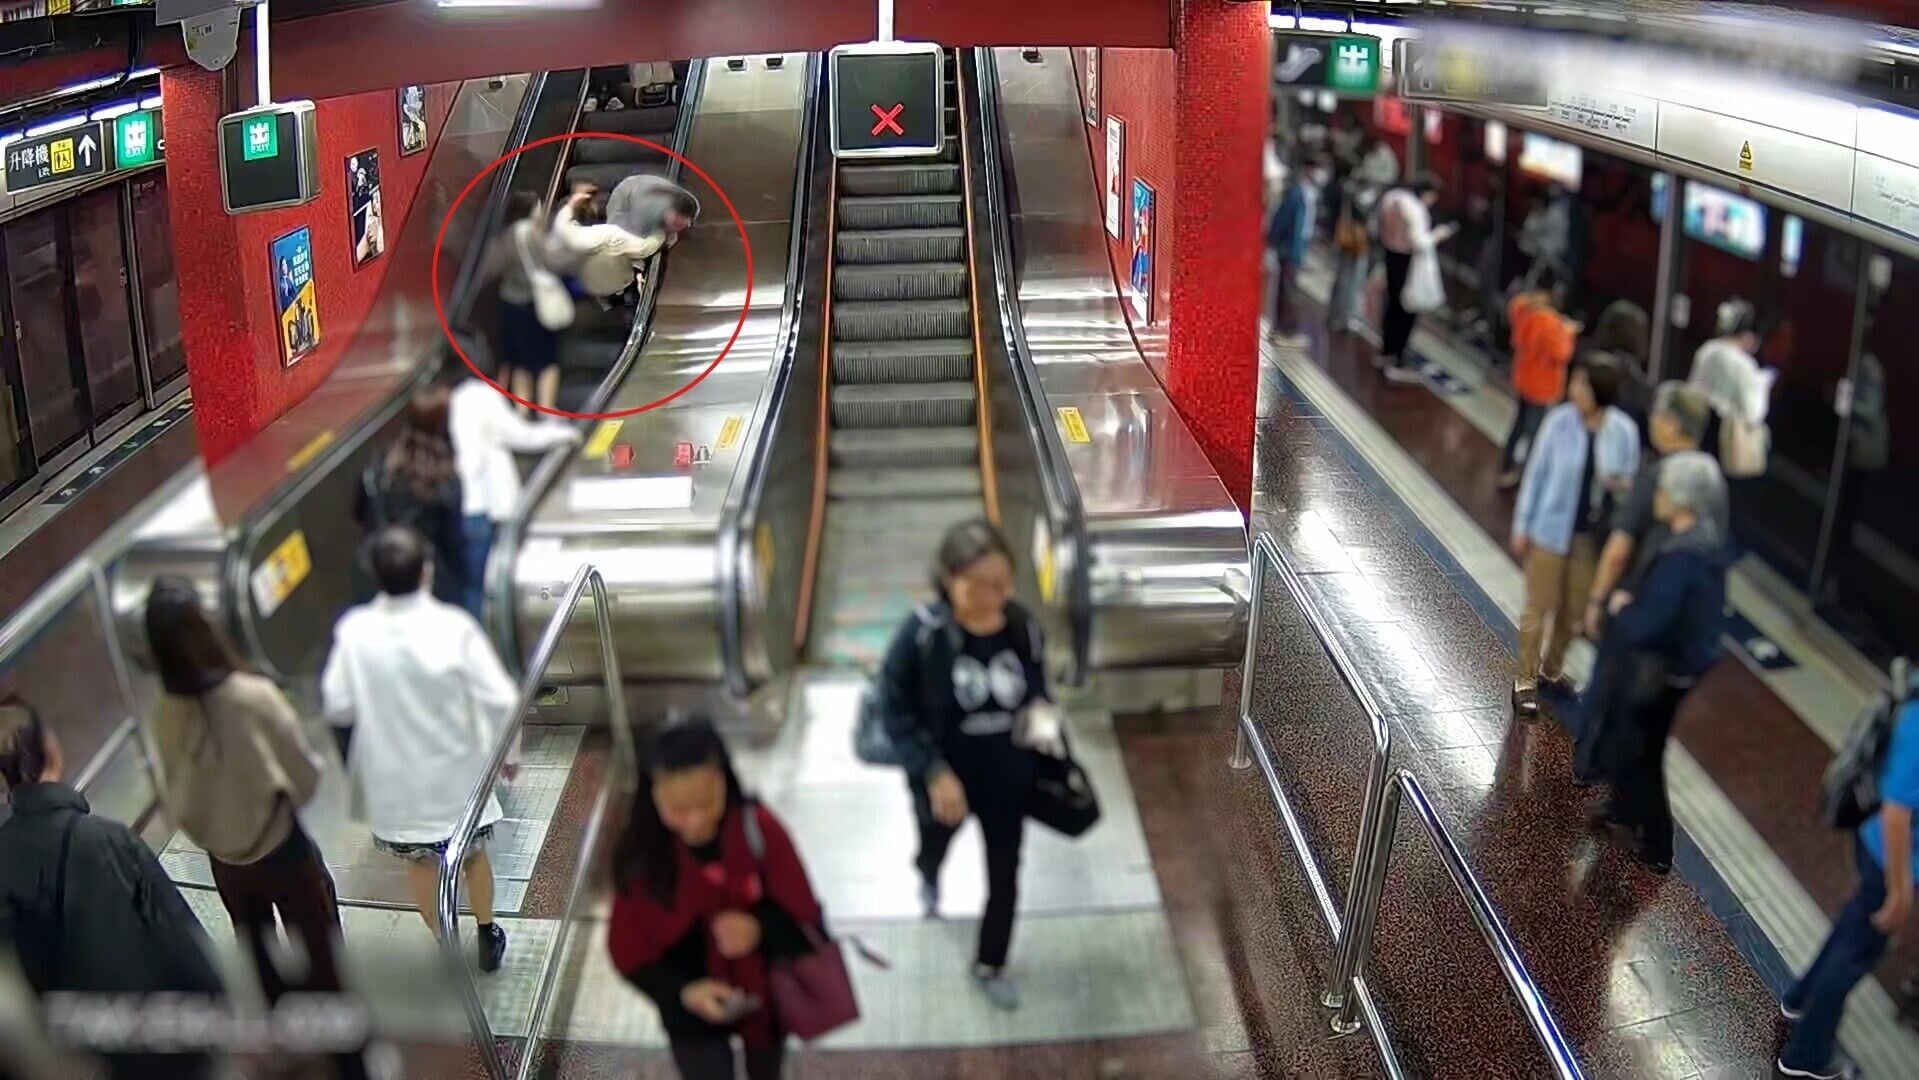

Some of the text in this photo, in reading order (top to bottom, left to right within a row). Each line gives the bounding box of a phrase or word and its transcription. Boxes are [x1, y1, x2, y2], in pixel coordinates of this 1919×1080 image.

[9, 144, 50, 172] 升降機
[250, 143, 269, 154] EXIT
